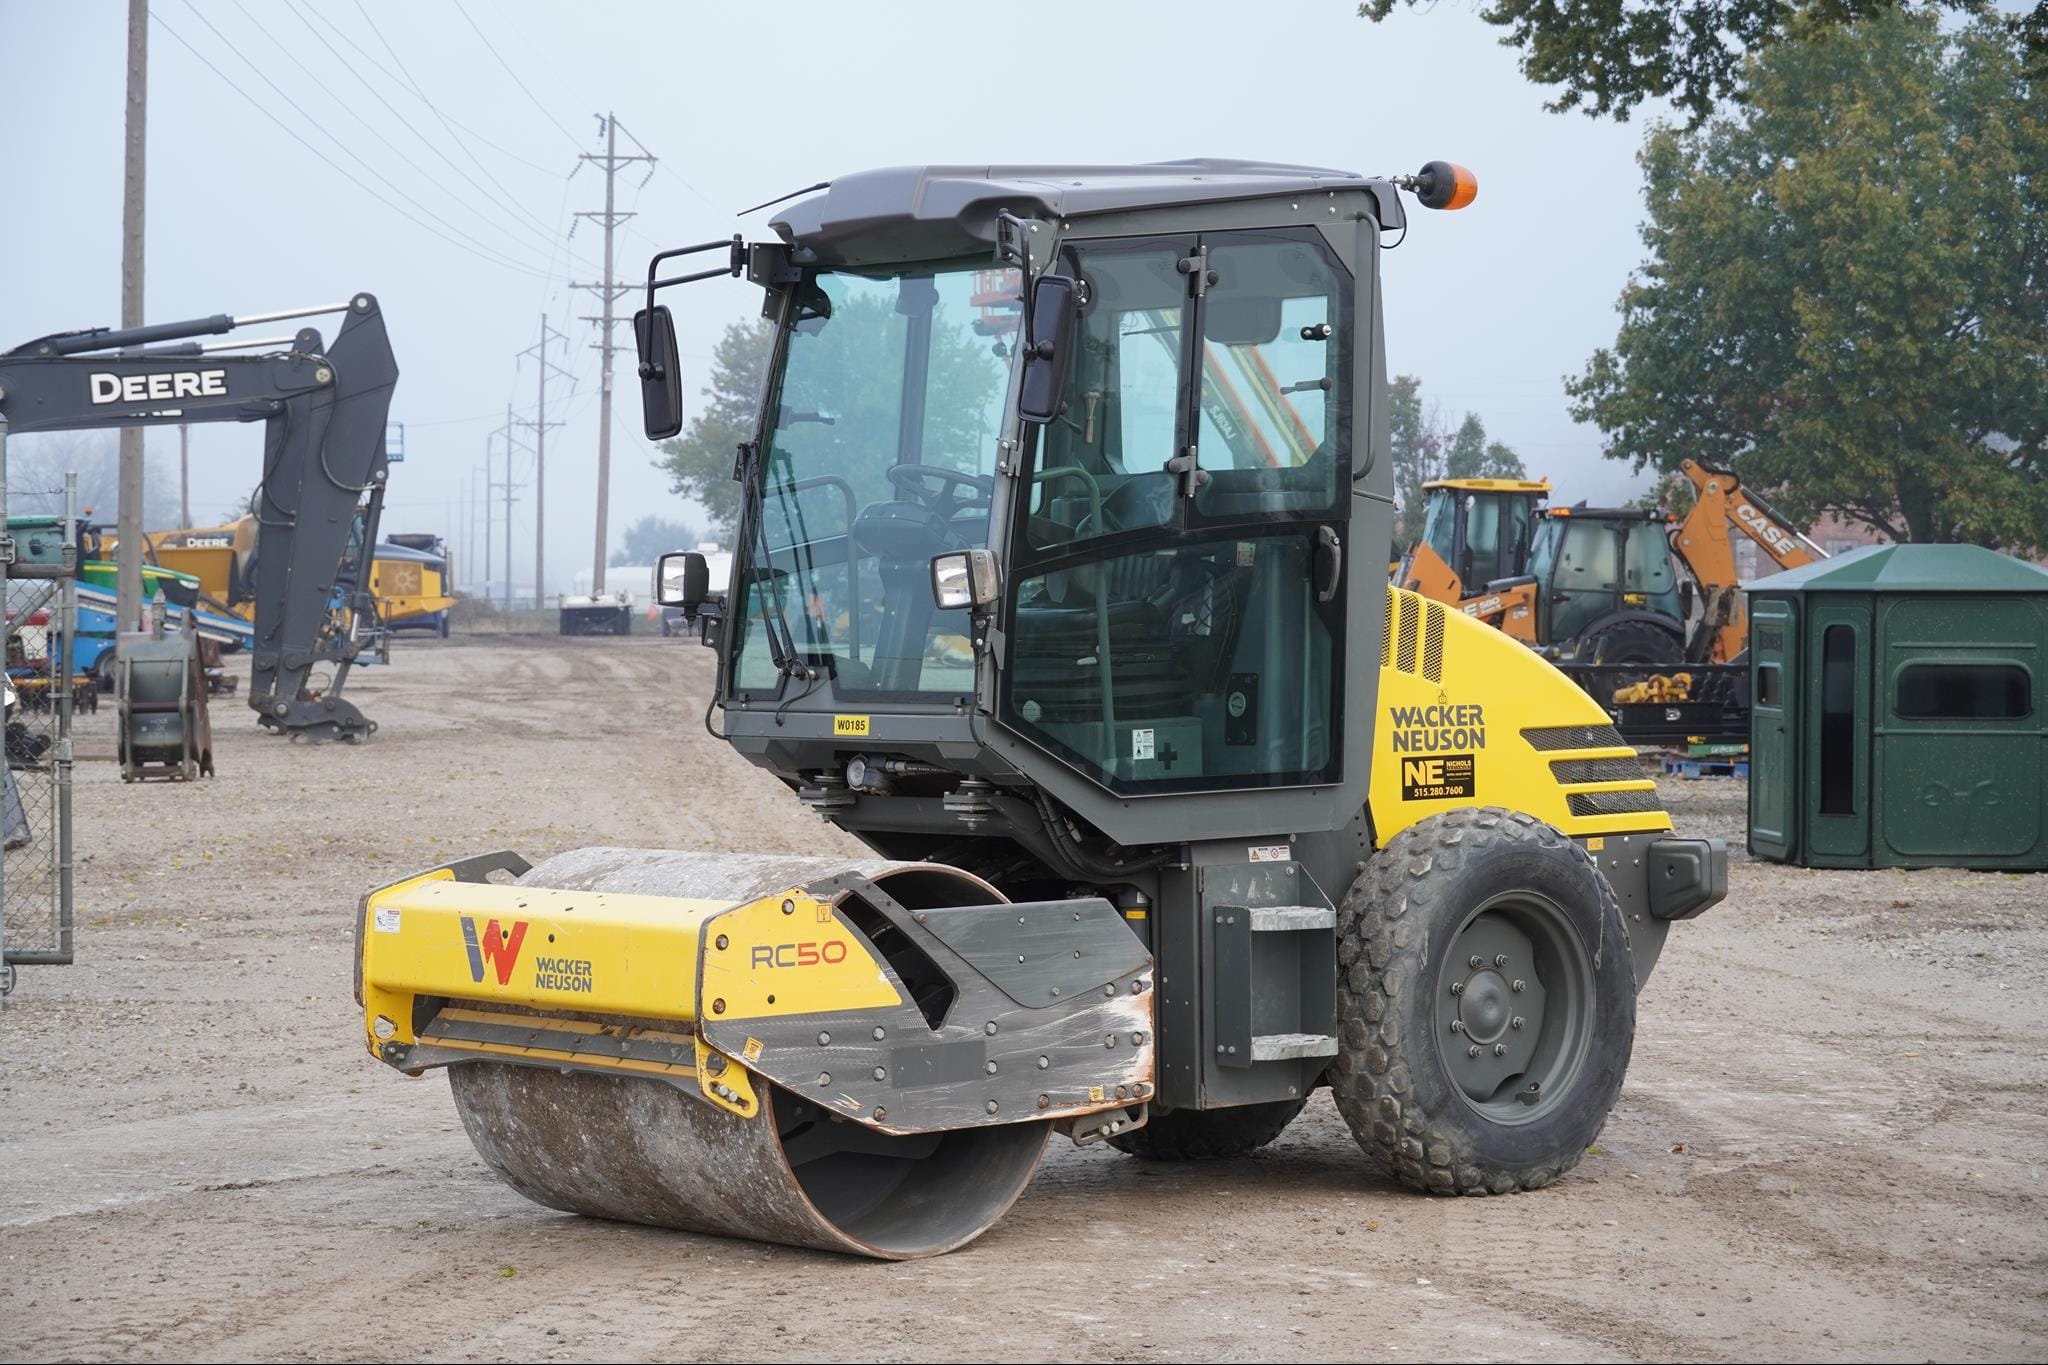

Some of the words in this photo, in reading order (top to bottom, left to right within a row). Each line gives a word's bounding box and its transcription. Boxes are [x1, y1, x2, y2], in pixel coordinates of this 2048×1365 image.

[90, 370, 226, 404] DEERE
[1737, 504, 1795, 555] CASE
[186, 537, 229, 548] DEERE
[837, 719, 866, 731] W0185
[1390, 704, 1485, 728] WACKER
[1392, 728, 1485, 752] NEUSON
[1405, 760, 1445, 787] NE
[1414, 785, 1464, 797] 515.280.7600
[536, 956, 593, 977] WACKER
[751, 940, 847, 970] RC50
[535, 973, 593, 993] NEUSON
